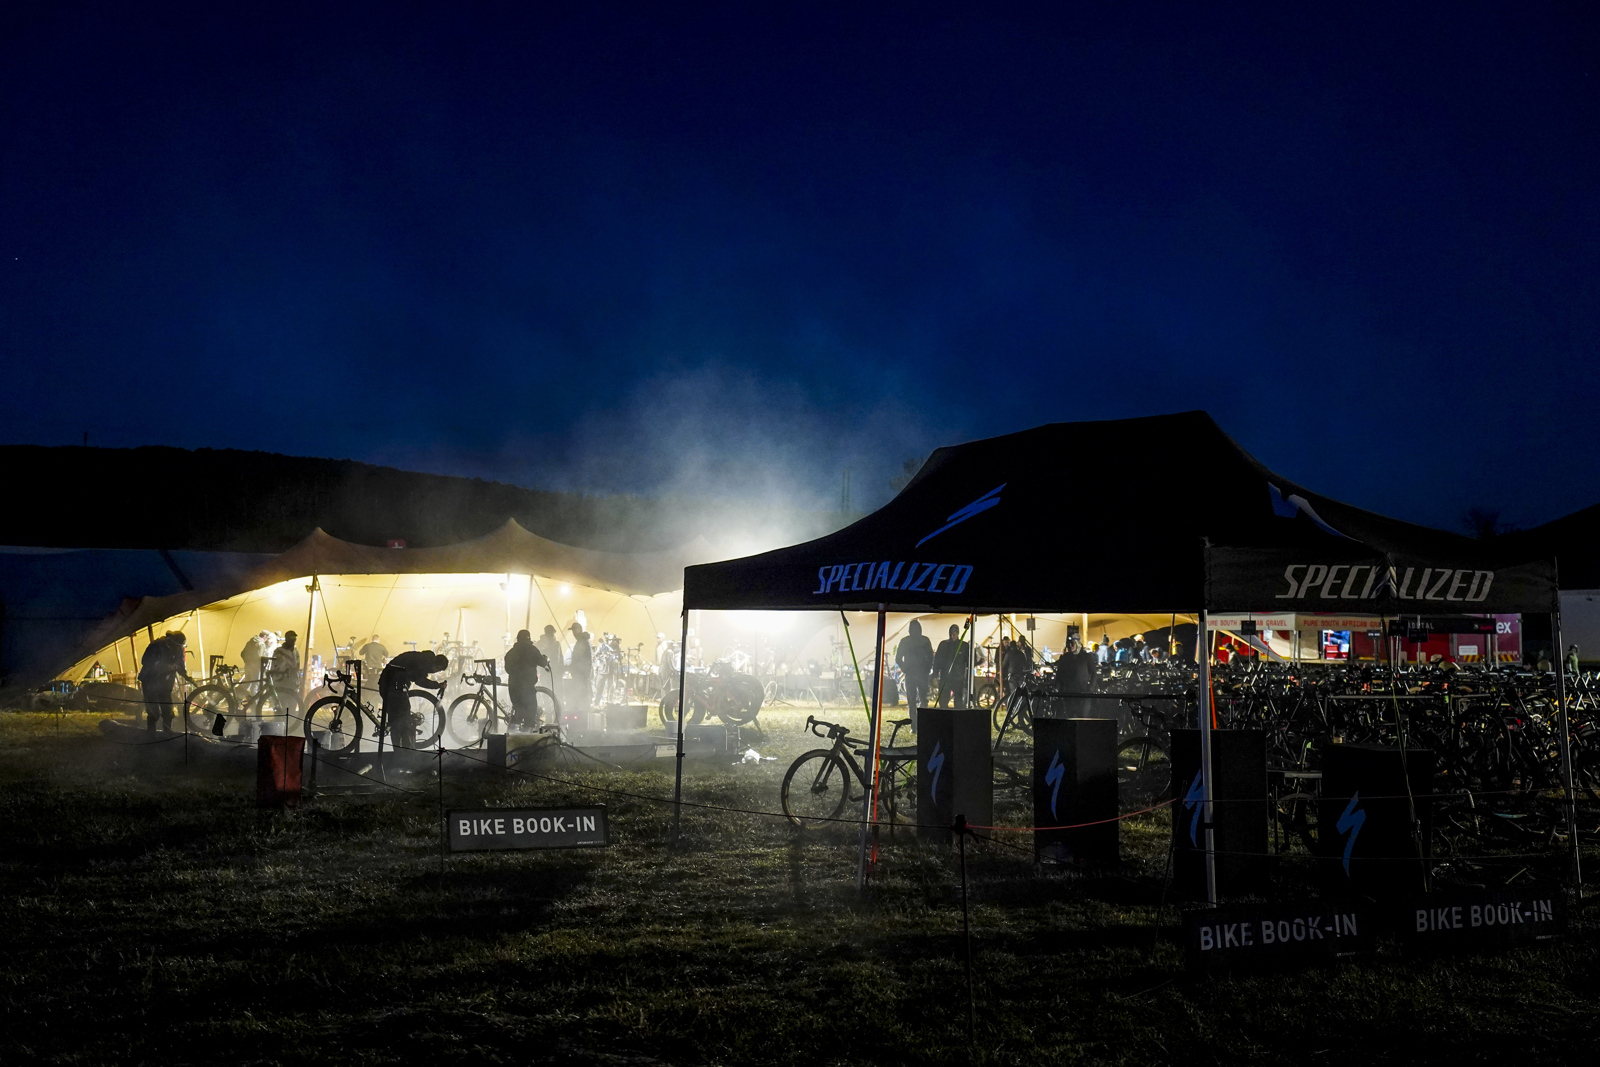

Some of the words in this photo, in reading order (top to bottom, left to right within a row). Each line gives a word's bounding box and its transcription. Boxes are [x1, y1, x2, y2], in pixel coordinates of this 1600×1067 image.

[813, 560, 974, 594] SPECIALIZED
[1275, 564, 1494, 602] SPECIALIZED
[1342, 620, 1367, 628] AFRICAN
[459, 818, 506, 835] BIKE
[512, 815, 596, 834] BOOK-IN
[1199, 922, 1253, 950] BIKE
[1261, 913, 1357, 944] BOOK-IN
[1416, 906, 1463, 932] BIKE
[1470, 899, 1553, 928] BOOK-IN
